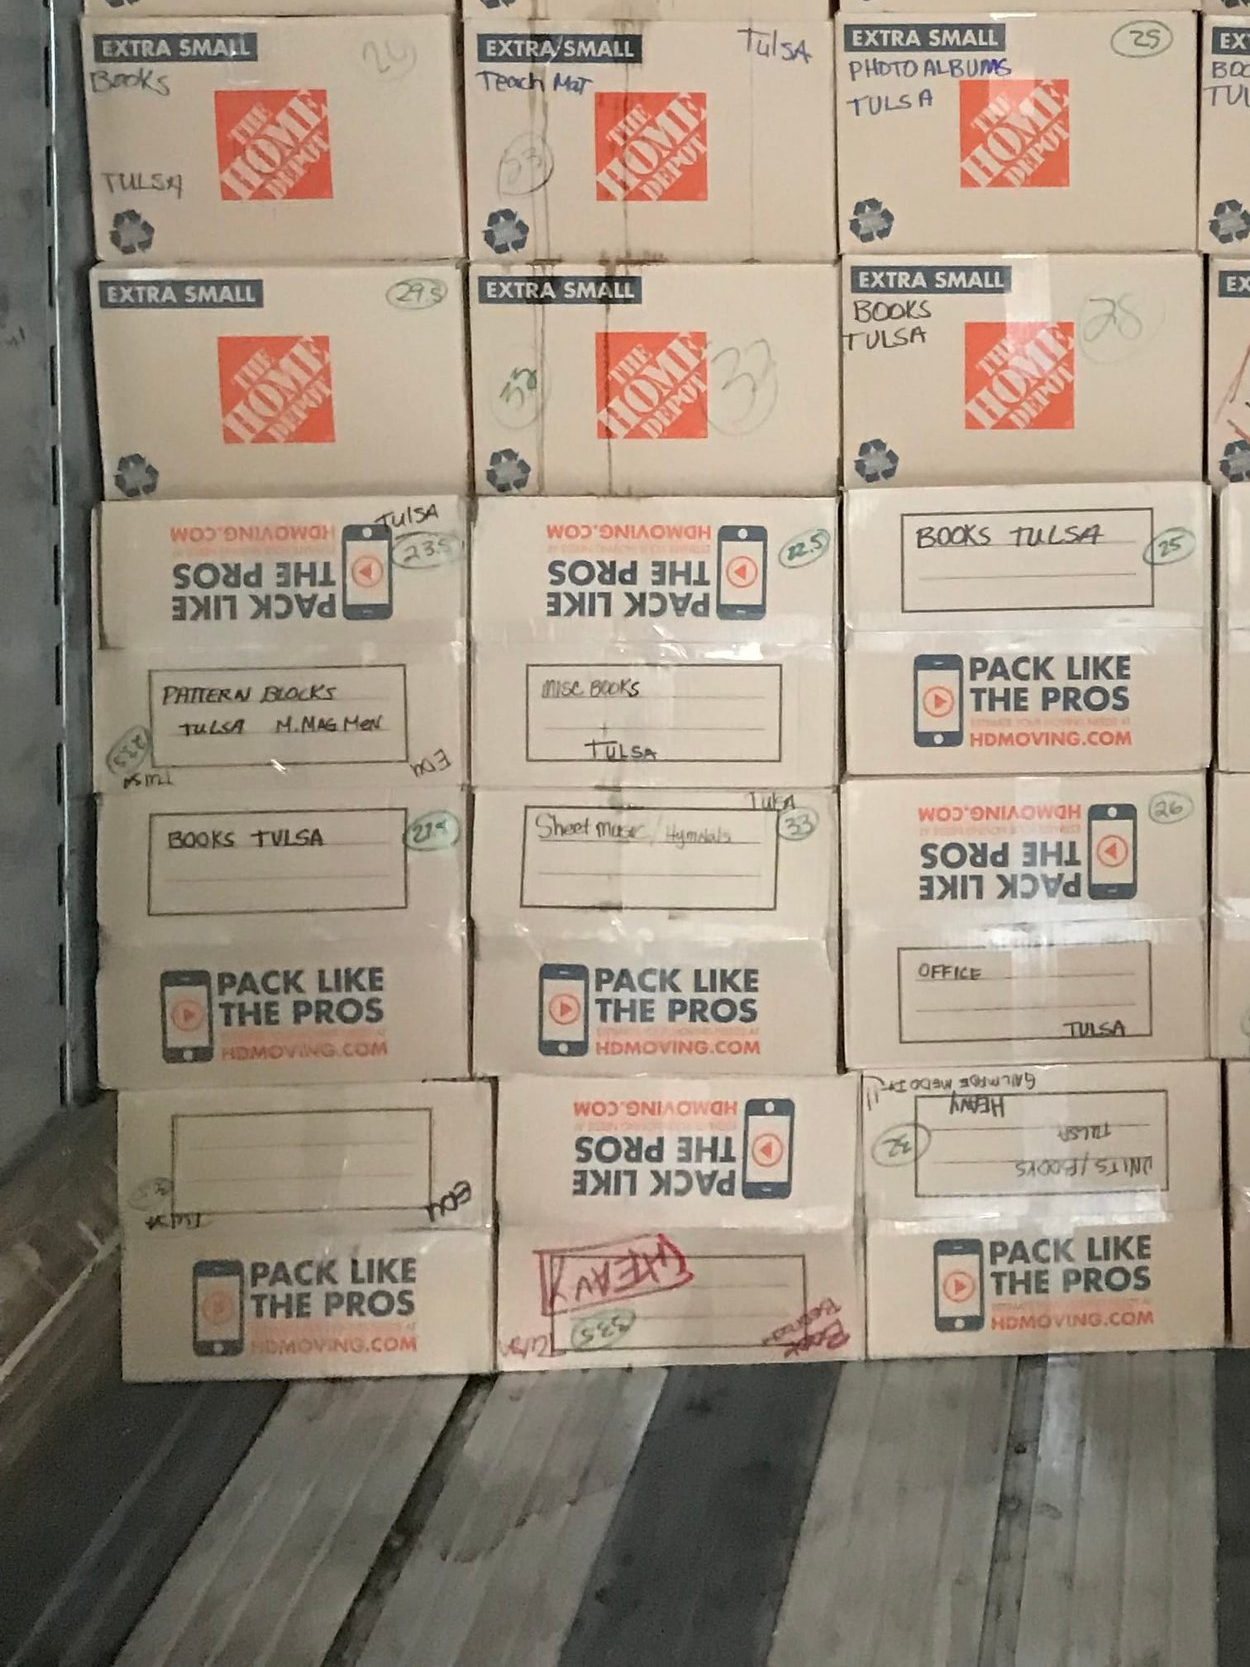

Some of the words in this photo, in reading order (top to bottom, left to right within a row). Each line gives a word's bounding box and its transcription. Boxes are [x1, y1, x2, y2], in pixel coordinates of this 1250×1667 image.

[852, 29, 921, 49] EXTRA
[928, 29, 999, 49] SMALL
[848, 59, 918, 80] PHOTO
[922, 58, 1012, 77] ALBUMS
[847, 90, 935, 113] TULSA
[107, 285, 177, 304] EXTRA
[184, 283, 256, 304] SMALL
[852, 300, 932, 321] BOOKS
[842, 325, 927, 350] TULSA
[235, 349, 273, 388] THE
[223, 336, 331, 442] HOME
[268, 379, 333, 443] DEPOT
[546, 524, 713, 543] HDMOVING.COM
[916, 524, 992, 550] BOOKS
[1008, 523, 1105, 547] TULSA
[547, 560, 640, 586] PROS
[652, 560, 711, 585] THE
[546, 592, 614, 617] LIKE
[622, 592, 710, 617] PACK
[970, 657, 1058, 681] PACK
[1066, 655, 1131, 680] LIKE
[163, 686, 252, 705] PATTERN
[260, 685, 337, 703] BLOCKS
[970, 687, 1034, 713] THE
[1043, 685, 1131, 710] PROS
[179, 718, 246, 736] TULSA
[585, 740, 658, 762] TULSA
[970, 731, 1133, 748] HDMOVING.COM
[168, 828, 235, 850] BOOKS
[251, 828, 325, 849] TULSA
[216, 970, 309, 996] PACK
[317, 967, 384, 994] LIKE
[918, 962, 982, 982] OFFICE
[220, 1001, 284, 1026] THE
[293, 997, 384, 1024] PROS
[1063, 1020, 1126, 1040] TULSA
[221, 1040, 388, 1061] HDMOVING.COM
